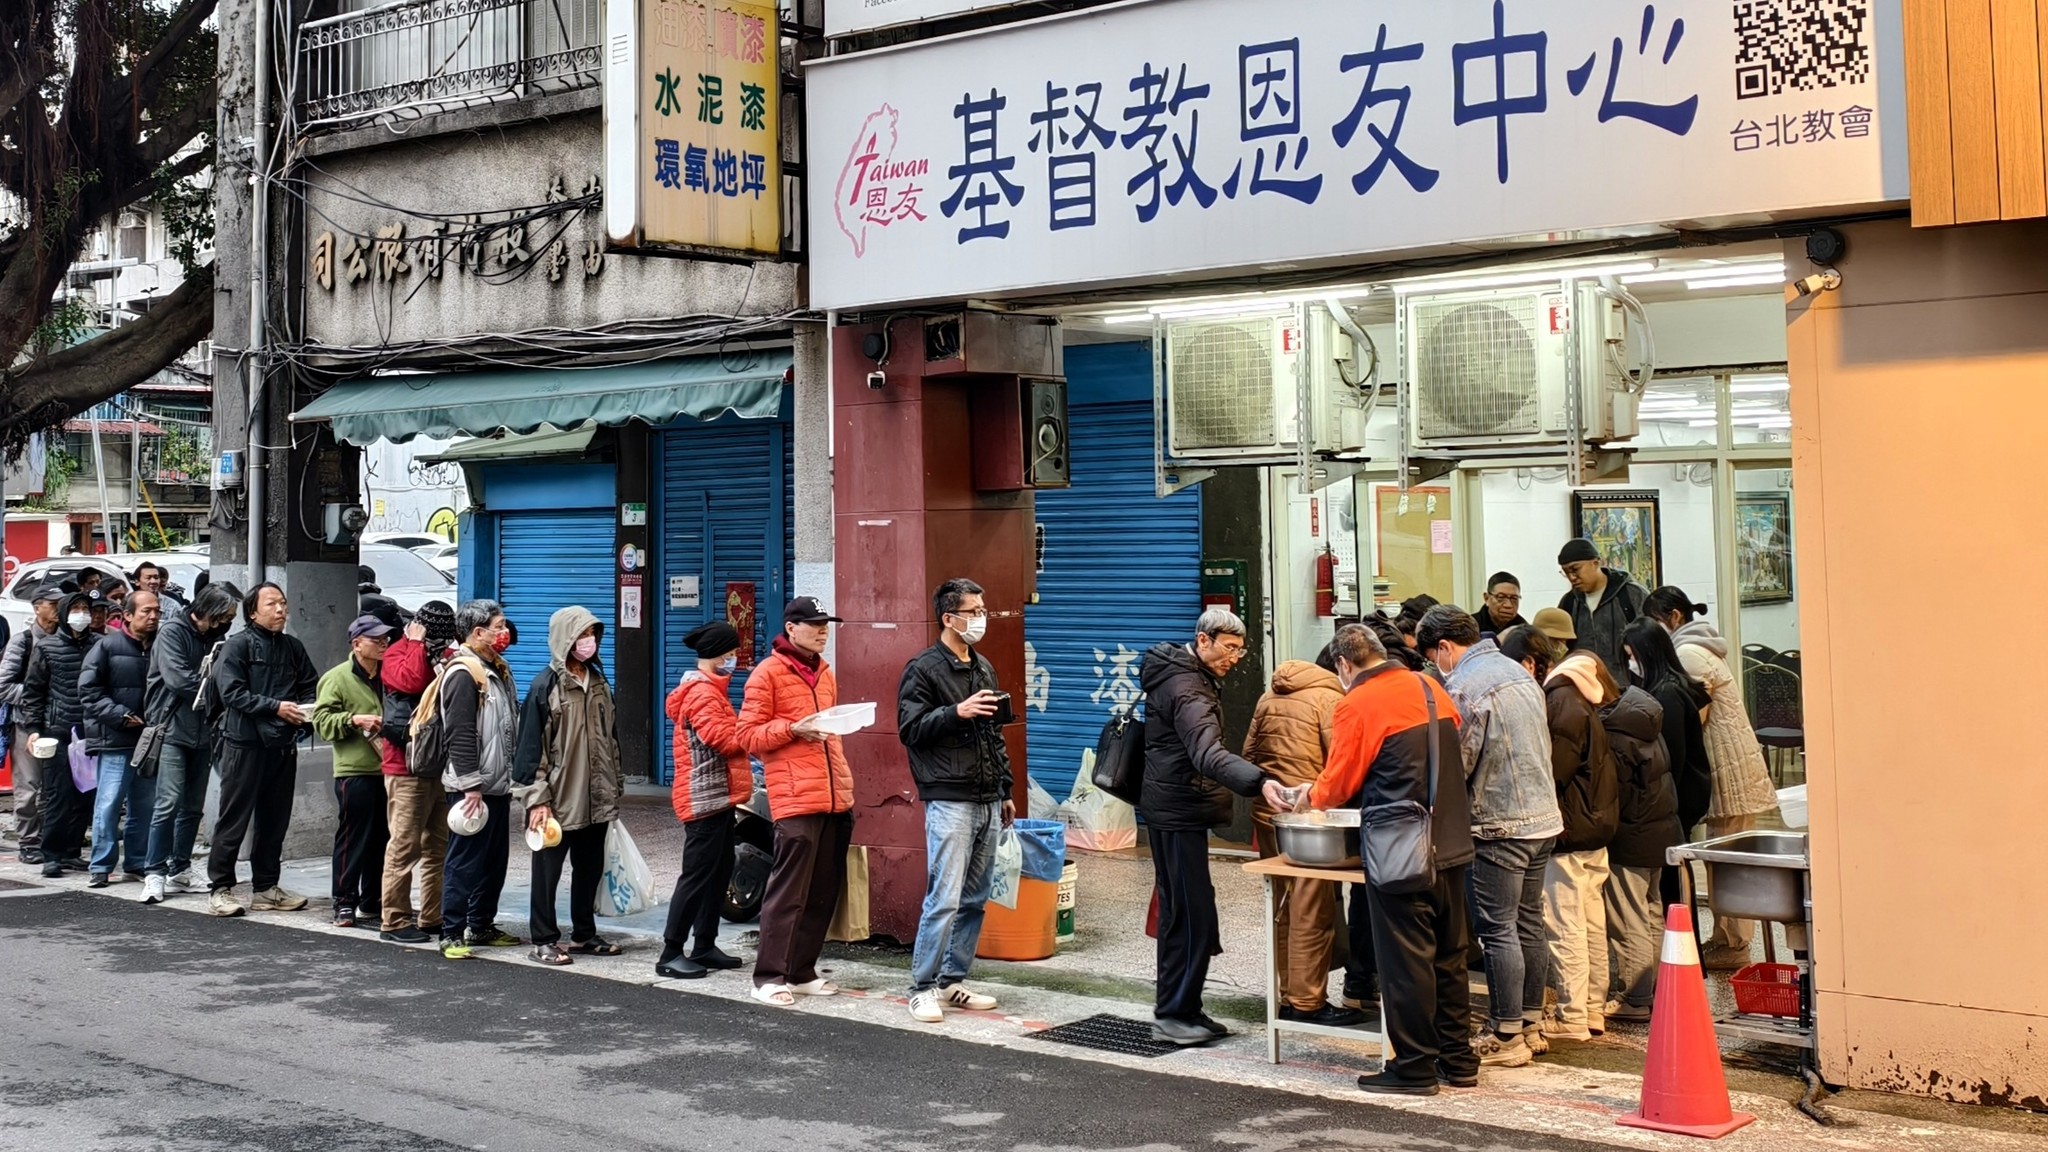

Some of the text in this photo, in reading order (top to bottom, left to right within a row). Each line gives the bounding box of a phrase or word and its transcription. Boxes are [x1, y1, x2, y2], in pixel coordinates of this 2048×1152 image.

[655, 65, 765, 130] 水泥漆
[940, 0, 1700, 245] 基督教恩友中心
[1730, 104, 1873, 151] 台北教會
[655, 137, 767, 201] 環氧地坪
[849, 131, 929, 206] Taiwan
[859, 182, 928, 227] 恩友
